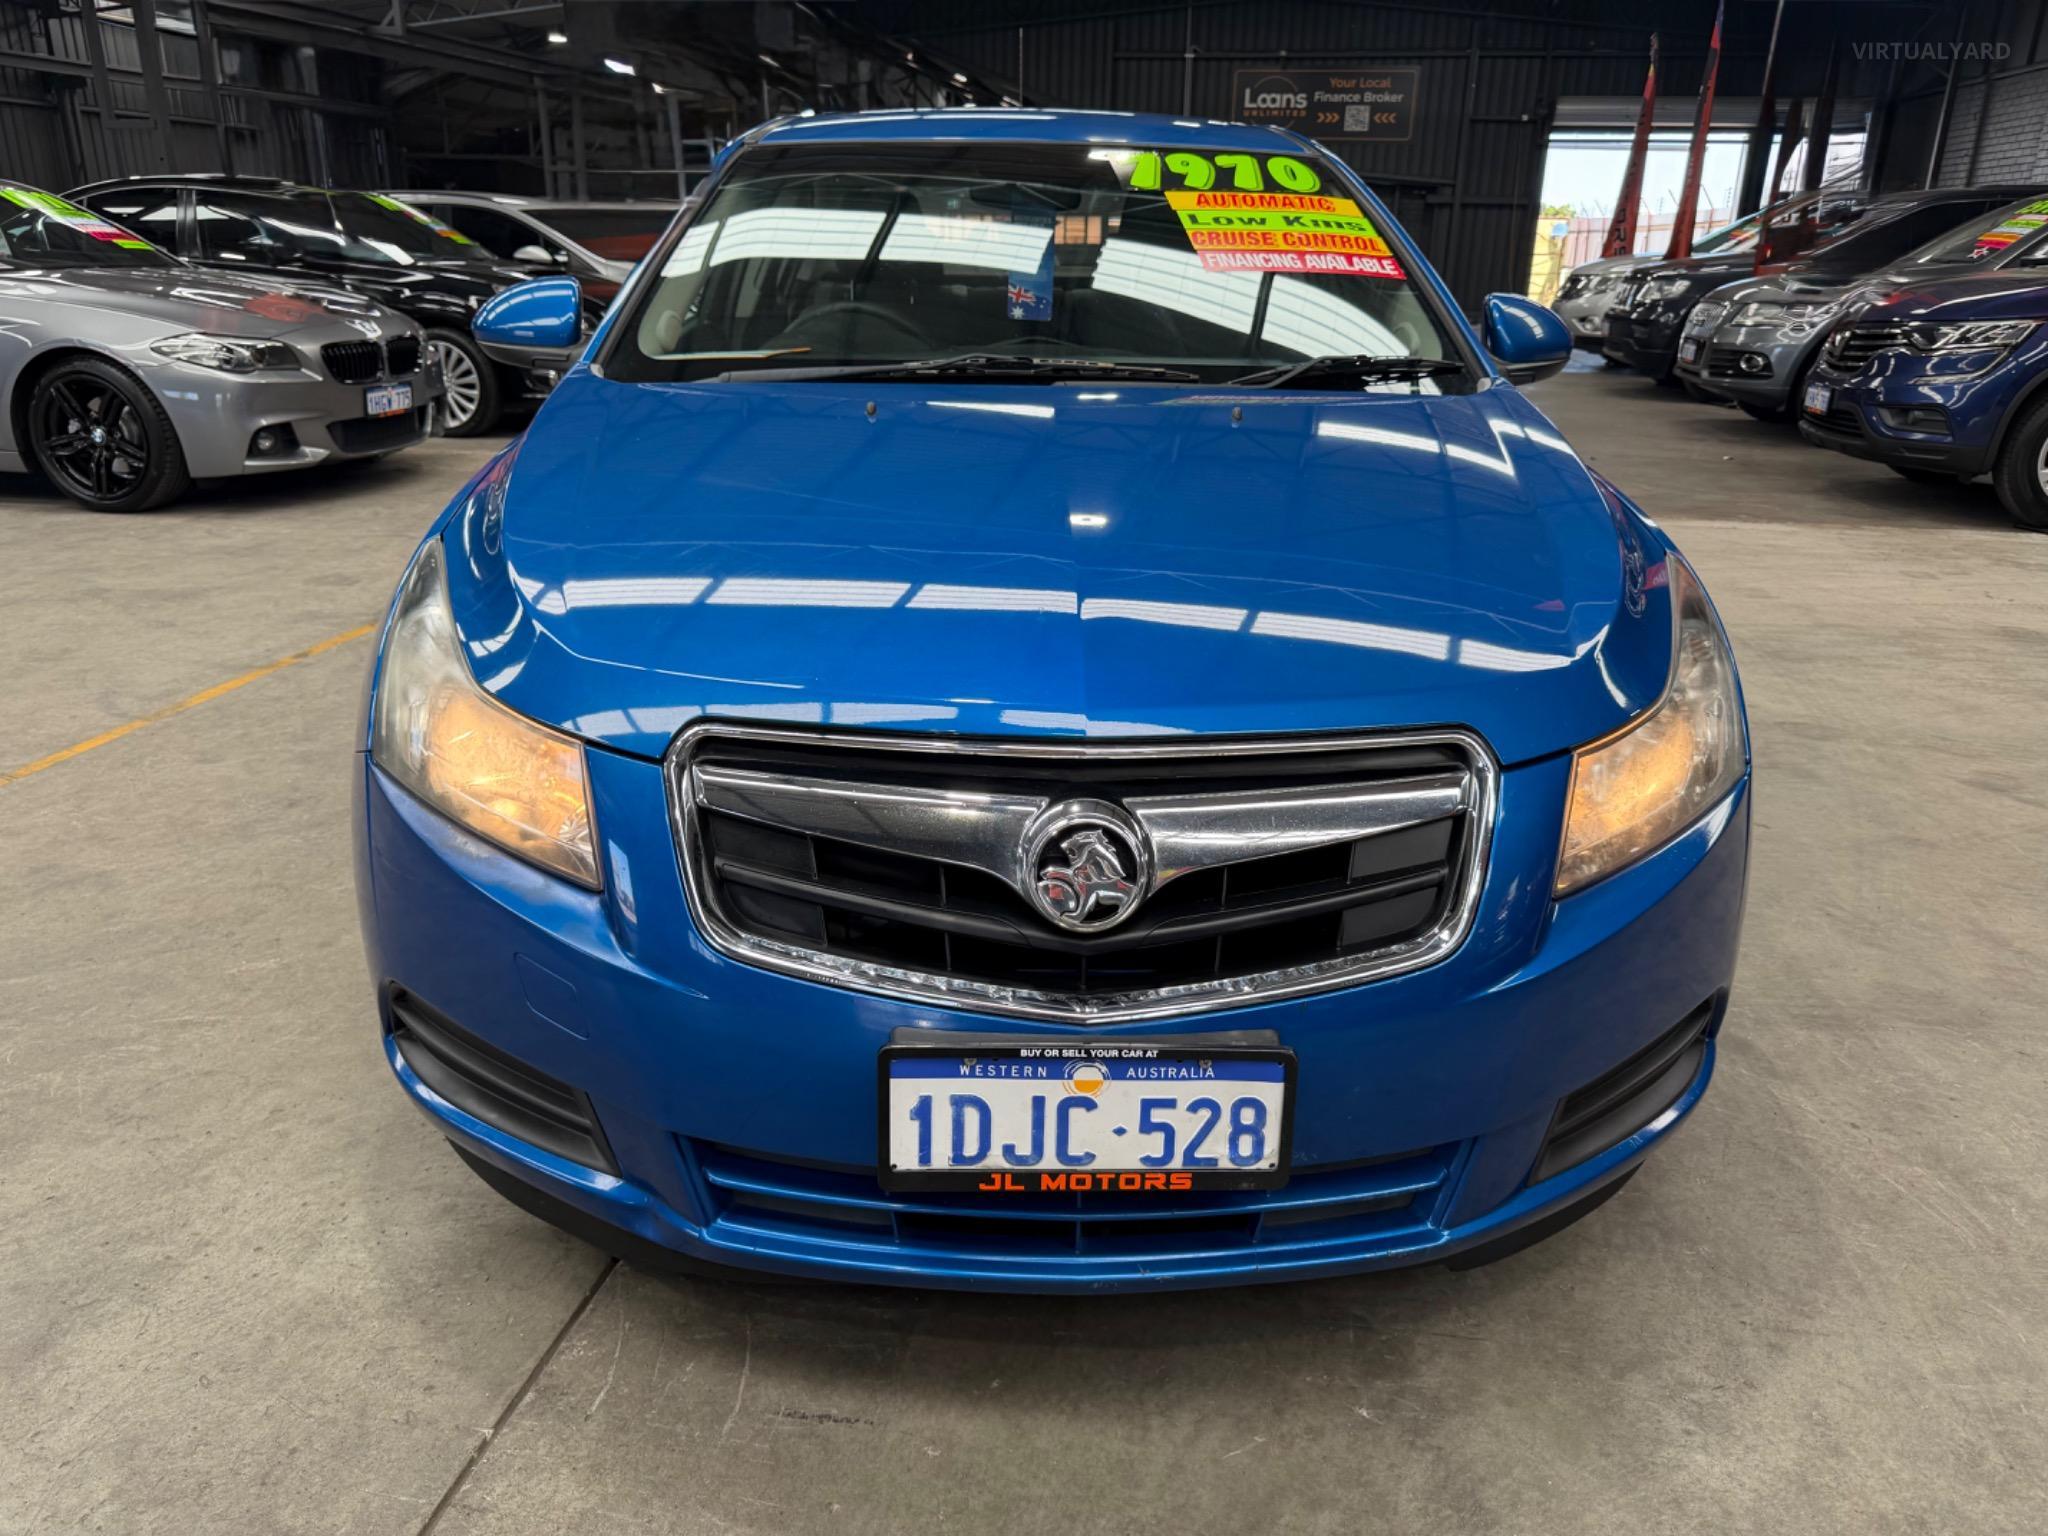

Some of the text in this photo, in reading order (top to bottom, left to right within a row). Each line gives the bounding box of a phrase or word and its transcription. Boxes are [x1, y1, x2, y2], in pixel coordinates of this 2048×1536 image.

[1329, 77, 1392, 89] Your Local
[1244, 88, 1308, 108] Loans
[1313, 91, 1405, 103] Finance Broker
[1196, 193, 1336, 212] AUTOMATIC
[1190, 231, 1382, 252] CRUISE CONTROL
[1207, 252, 1399, 275] FINANCING AVAILABLE
[1020, 1049, 1158, 1058] BUY OR SELL YOUR CAR AT
[959, 1064, 1215, 1079] WESTERN AUSTRALIA
[979, 1173, 1193, 1191] JL MOTORS
